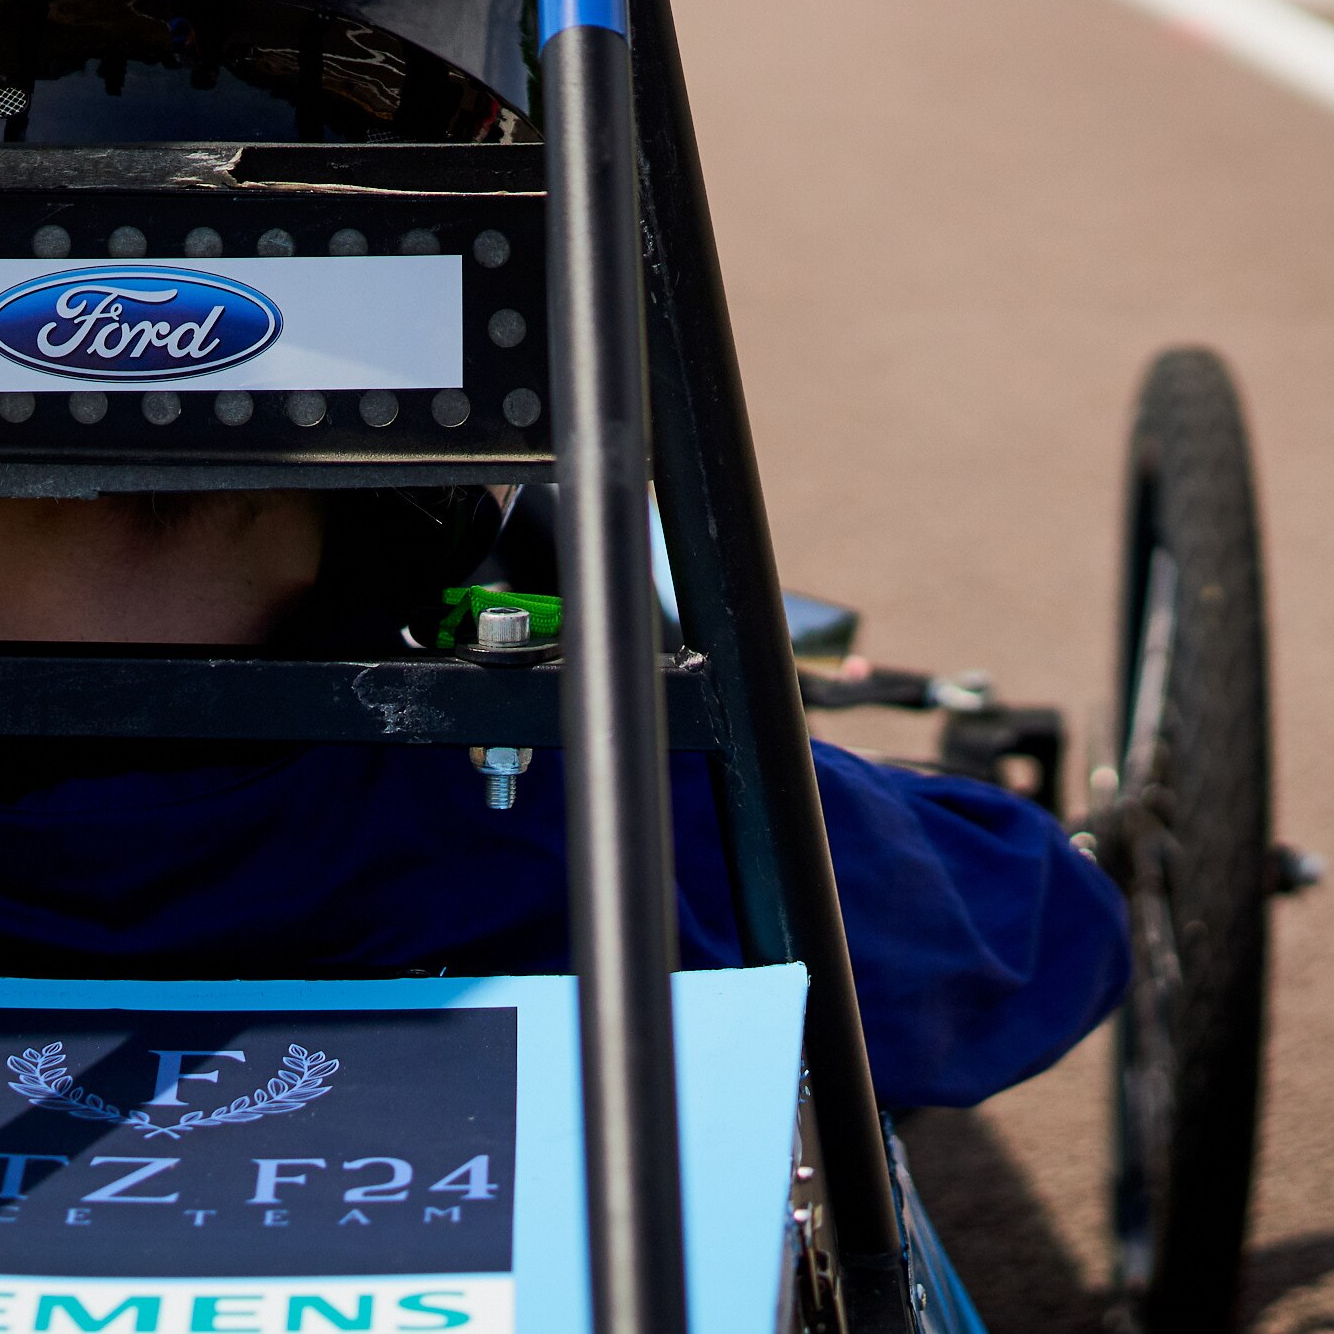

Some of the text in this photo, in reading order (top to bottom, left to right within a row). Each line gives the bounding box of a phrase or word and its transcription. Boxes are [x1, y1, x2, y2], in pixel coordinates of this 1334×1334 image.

[37, 284, 225, 359] Ford
[142, 1050, 245, 1106] F
[246, 1154, 499, 1205] F24
[184, 1206, 463, 1227] TEAM
